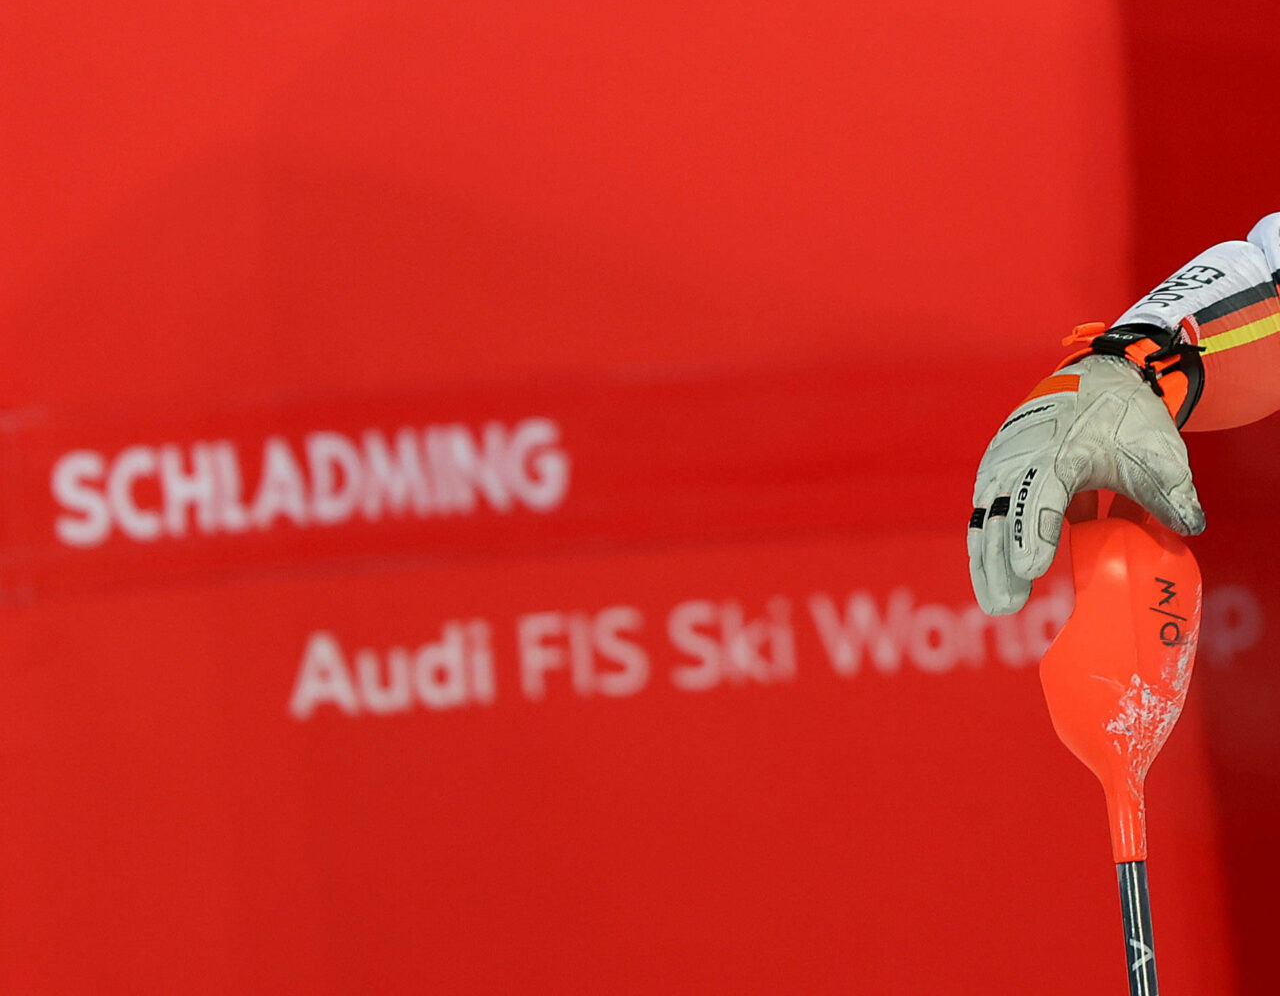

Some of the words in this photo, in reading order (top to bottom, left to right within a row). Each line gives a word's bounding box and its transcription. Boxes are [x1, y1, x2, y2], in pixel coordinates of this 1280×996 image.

[51, 415, 571, 548] SCHLADMING
[1014, 467, 1038, 549] ziener
[290, 616, 497, 721] Audi
[516, 604, 649, 701] FIS
[667, 592, 798, 692] Ski
